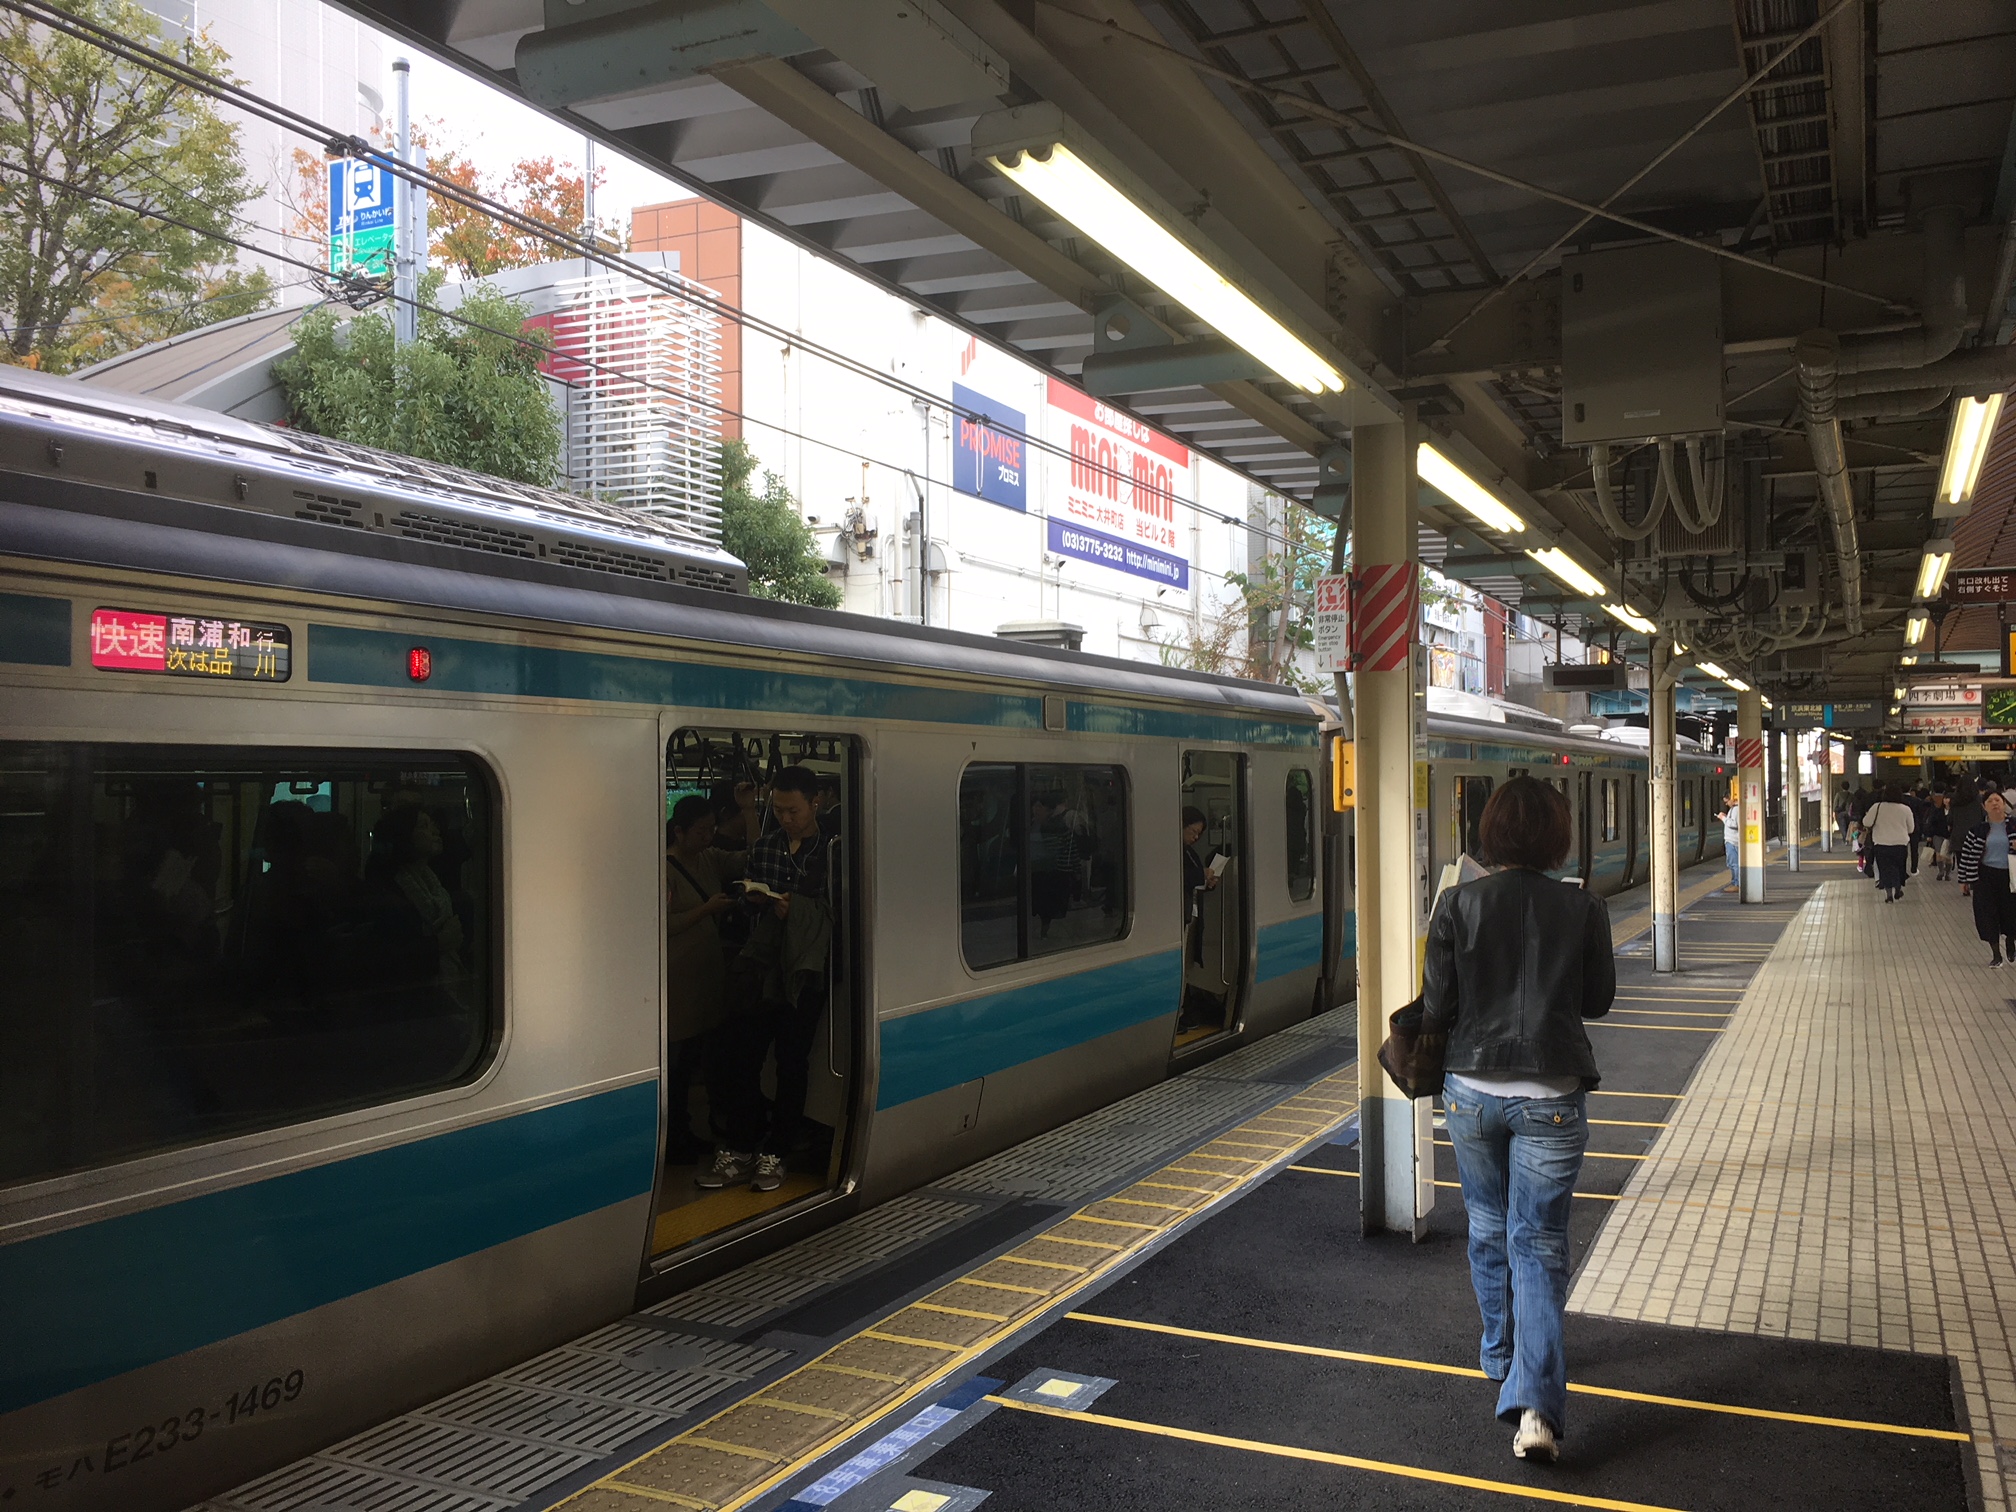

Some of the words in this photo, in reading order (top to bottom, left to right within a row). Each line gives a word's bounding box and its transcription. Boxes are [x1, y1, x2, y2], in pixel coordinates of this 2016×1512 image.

[960, 418, 1021, 469] PROMISE
[998, 465, 1020, 487] プロミス
[1070, 423, 1118, 503] mini
[1132, 450, 1174, 524] mini
[1062, 529, 1123, 563] (03)3775-3232
[1126, 548, 1180, 581] http://minimini.jp
[1957, 575, 2009, 586] 東口改札出て
[1957, 584, 2009, 594] 右側すぐそこ
[1318, 614, 1344, 624] 非常停止
[91, 616, 165, 659] 快速
[1318, 625, 1338, 635] ボタン
[1779, 704, 1786, 721] 1
